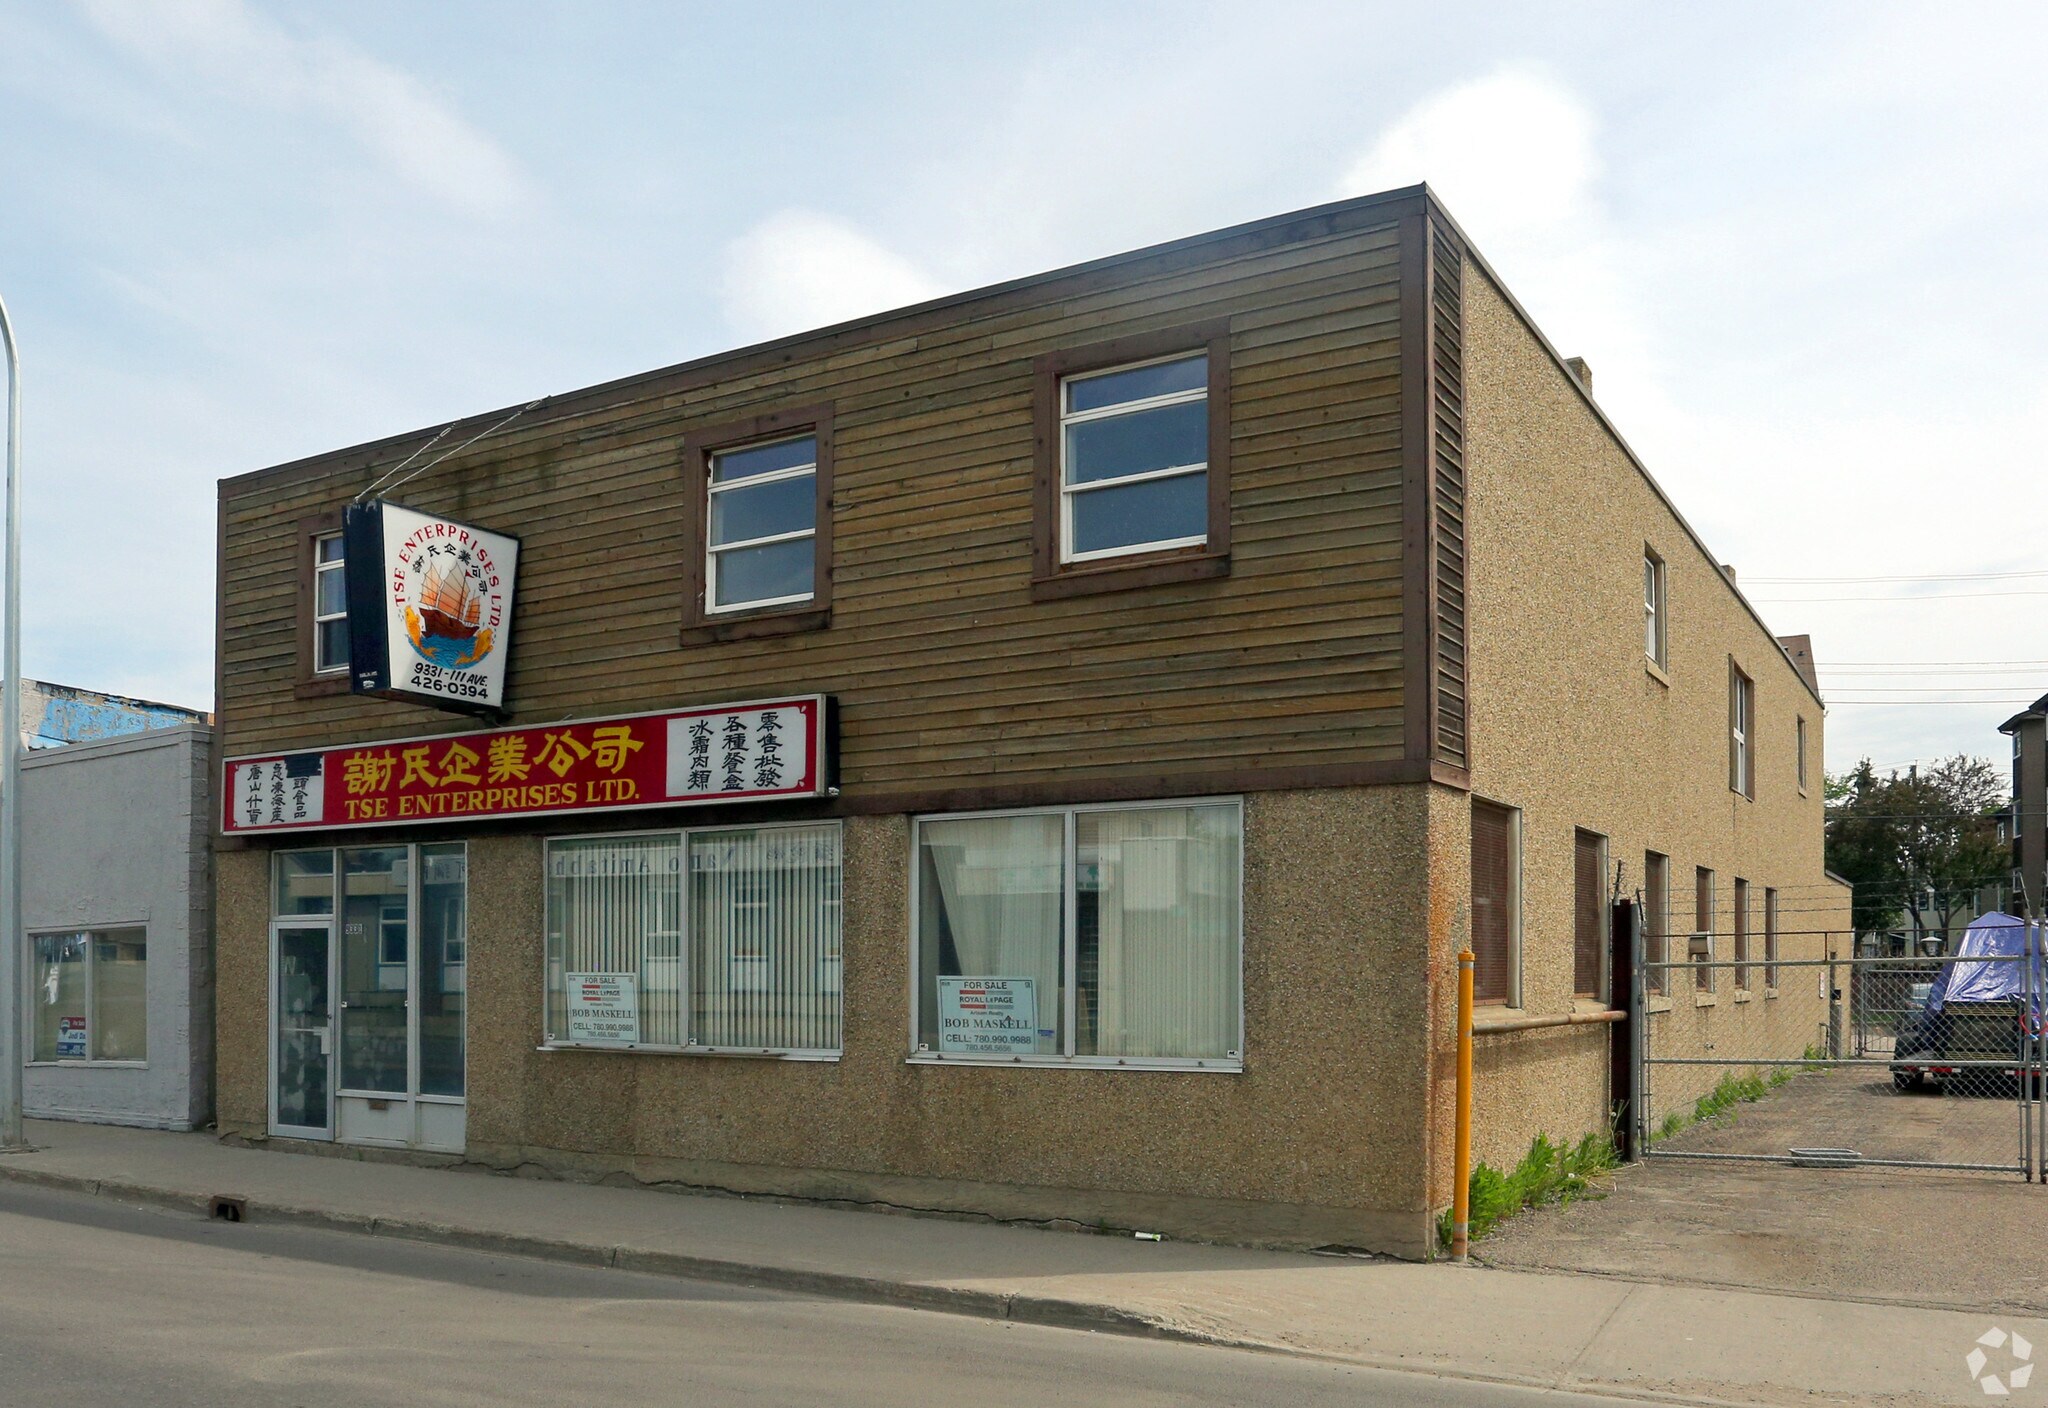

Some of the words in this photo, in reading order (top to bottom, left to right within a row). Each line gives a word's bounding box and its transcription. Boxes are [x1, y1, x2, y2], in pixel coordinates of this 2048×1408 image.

[399, 523, 500, 587] ENTERPRISES
[393, 567, 406, 607] TSE
[488, 595, 502, 627] LTD.
[411, 675, 488, 699] 426-0394
[466, 673, 488, 687] AVE.
[342, 725, 644, 796] 謝氏企業公司
[753, 711, 785, 788] 零售批發
[292, 775, 309, 819] 頭食品
[345, 798, 389, 820] TSE
[396, 782, 577, 816] ENTERPRISES
[585, 778, 640, 803] LTD.
[963, 981, 982, 989] FOR
[984, 981, 1007, 989] SALE
[572, 1009, 590, 1017] BOB
[592, 1010, 634, 1019] MASKELL
[944, 1018, 969, 1028] BOB
[973, 1019, 1032, 1030] MASKELL
[945, 1034, 971, 1042] CELL:
[974, 1034, 1032, 1044] 780.990.9988
